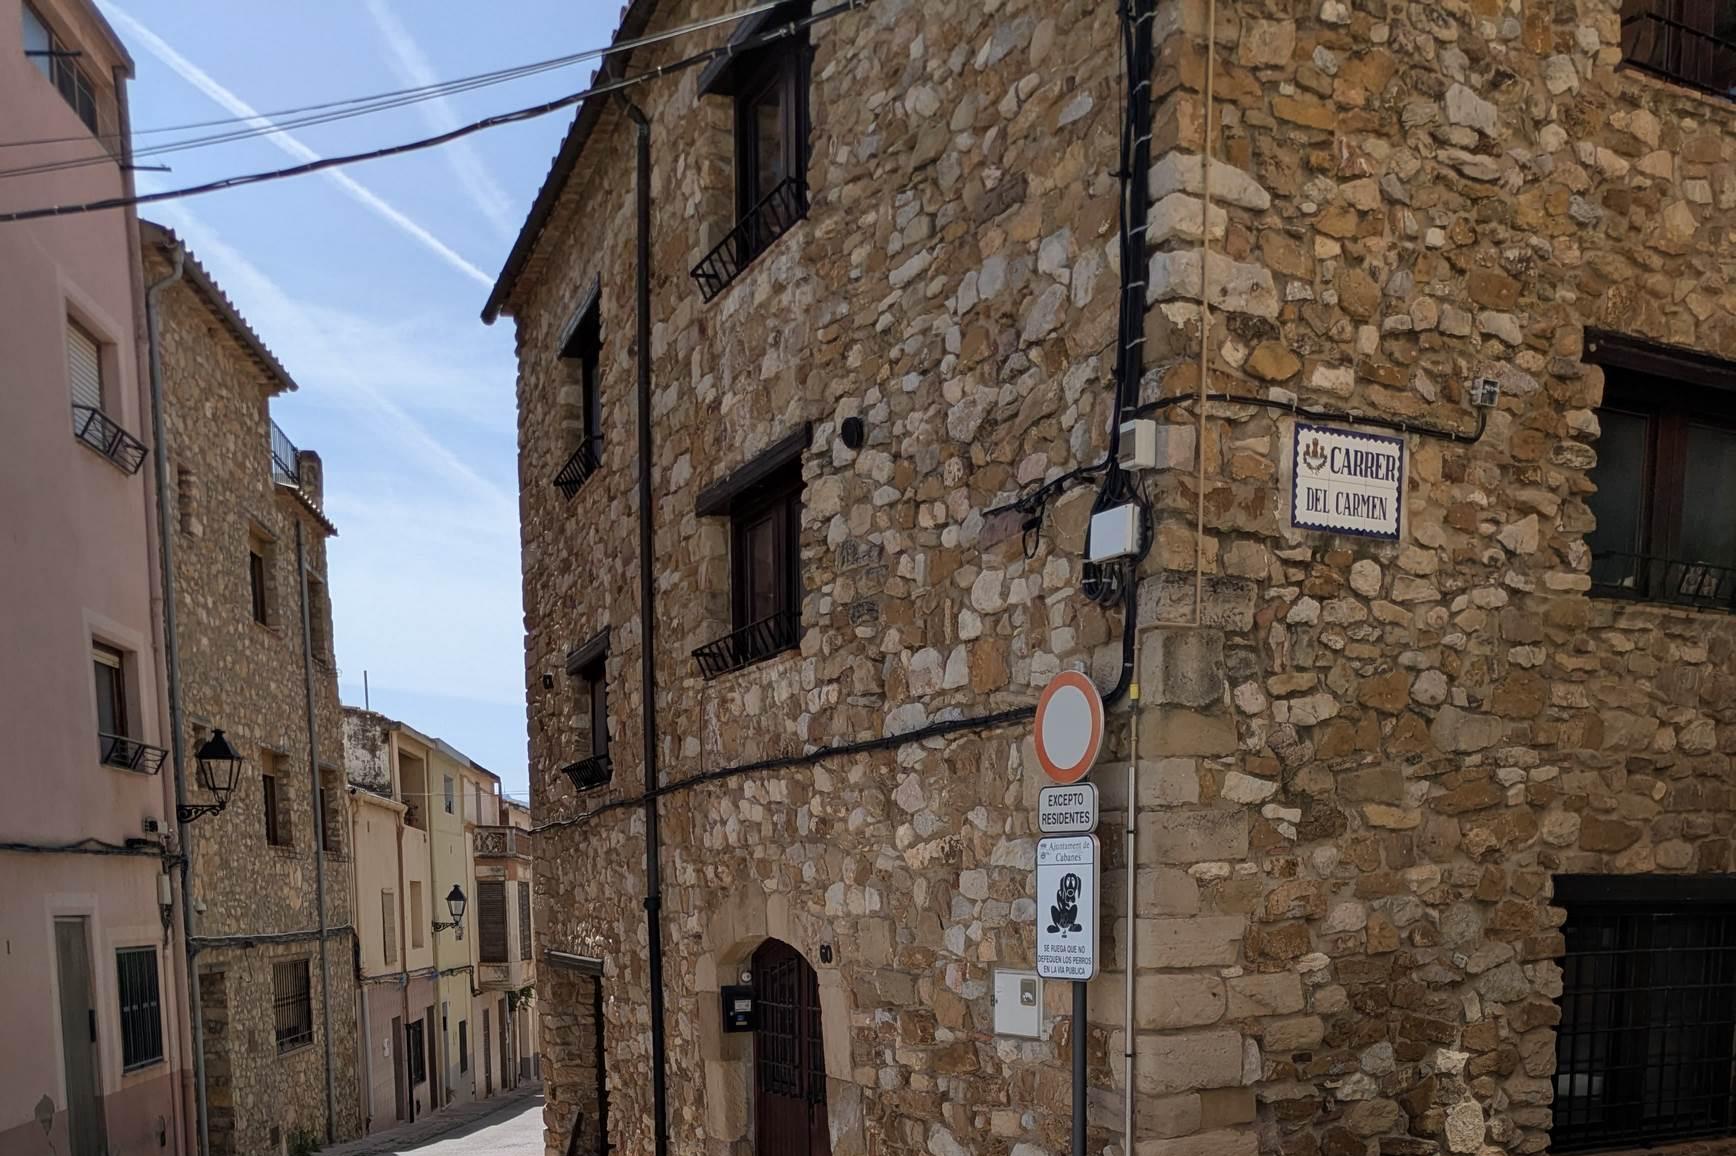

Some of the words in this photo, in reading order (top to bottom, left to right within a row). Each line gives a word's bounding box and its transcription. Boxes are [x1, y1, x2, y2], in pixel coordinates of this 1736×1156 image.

[1330, 446, 1395, 481] CARRER
[1306, 487, 1329, 513] DEL
[1336, 491, 1387, 520] CARMEN
[1048, 793, 1083, 806] EXCEPTO
[1042, 811, 1089, 824] RESIDENTES
[1049, 842, 1082, 850] Ajuntament
[1056, 852, 1081, 861] Cabanes
[1067, 945, 1077, 953] QUE
[1063, 956, 1072, 964] LOS
[1073, 956, 1091, 965] PERROS
[1044, 965, 1050, 973] EN
